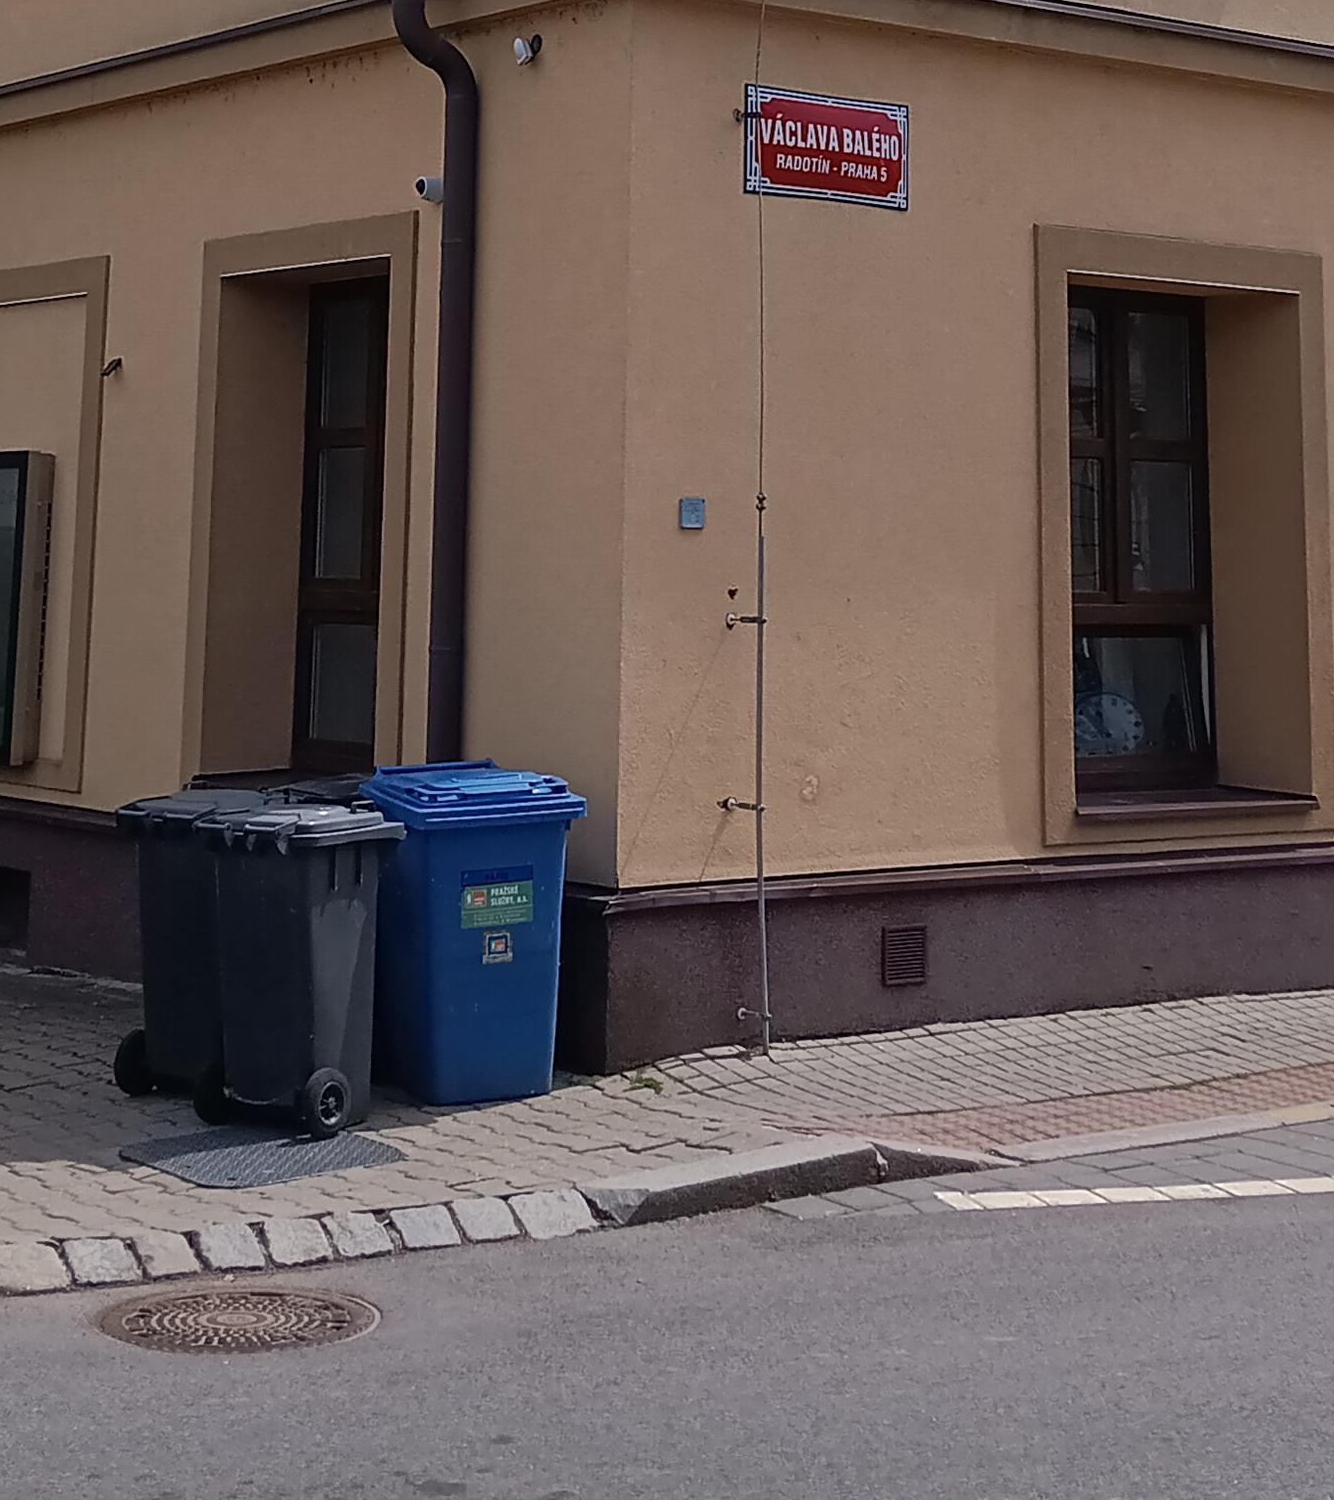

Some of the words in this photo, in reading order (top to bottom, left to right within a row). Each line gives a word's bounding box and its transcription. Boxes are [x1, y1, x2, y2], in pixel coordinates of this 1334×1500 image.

[760, 112, 840, 152] VÁCLAVA
[842, 126, 899, 162] BALÉHO
[775, 153, 831, 175] RADOTÍN
[840, 161, 878, 181] PRAHA
[880, 166, 888, 182] 5
